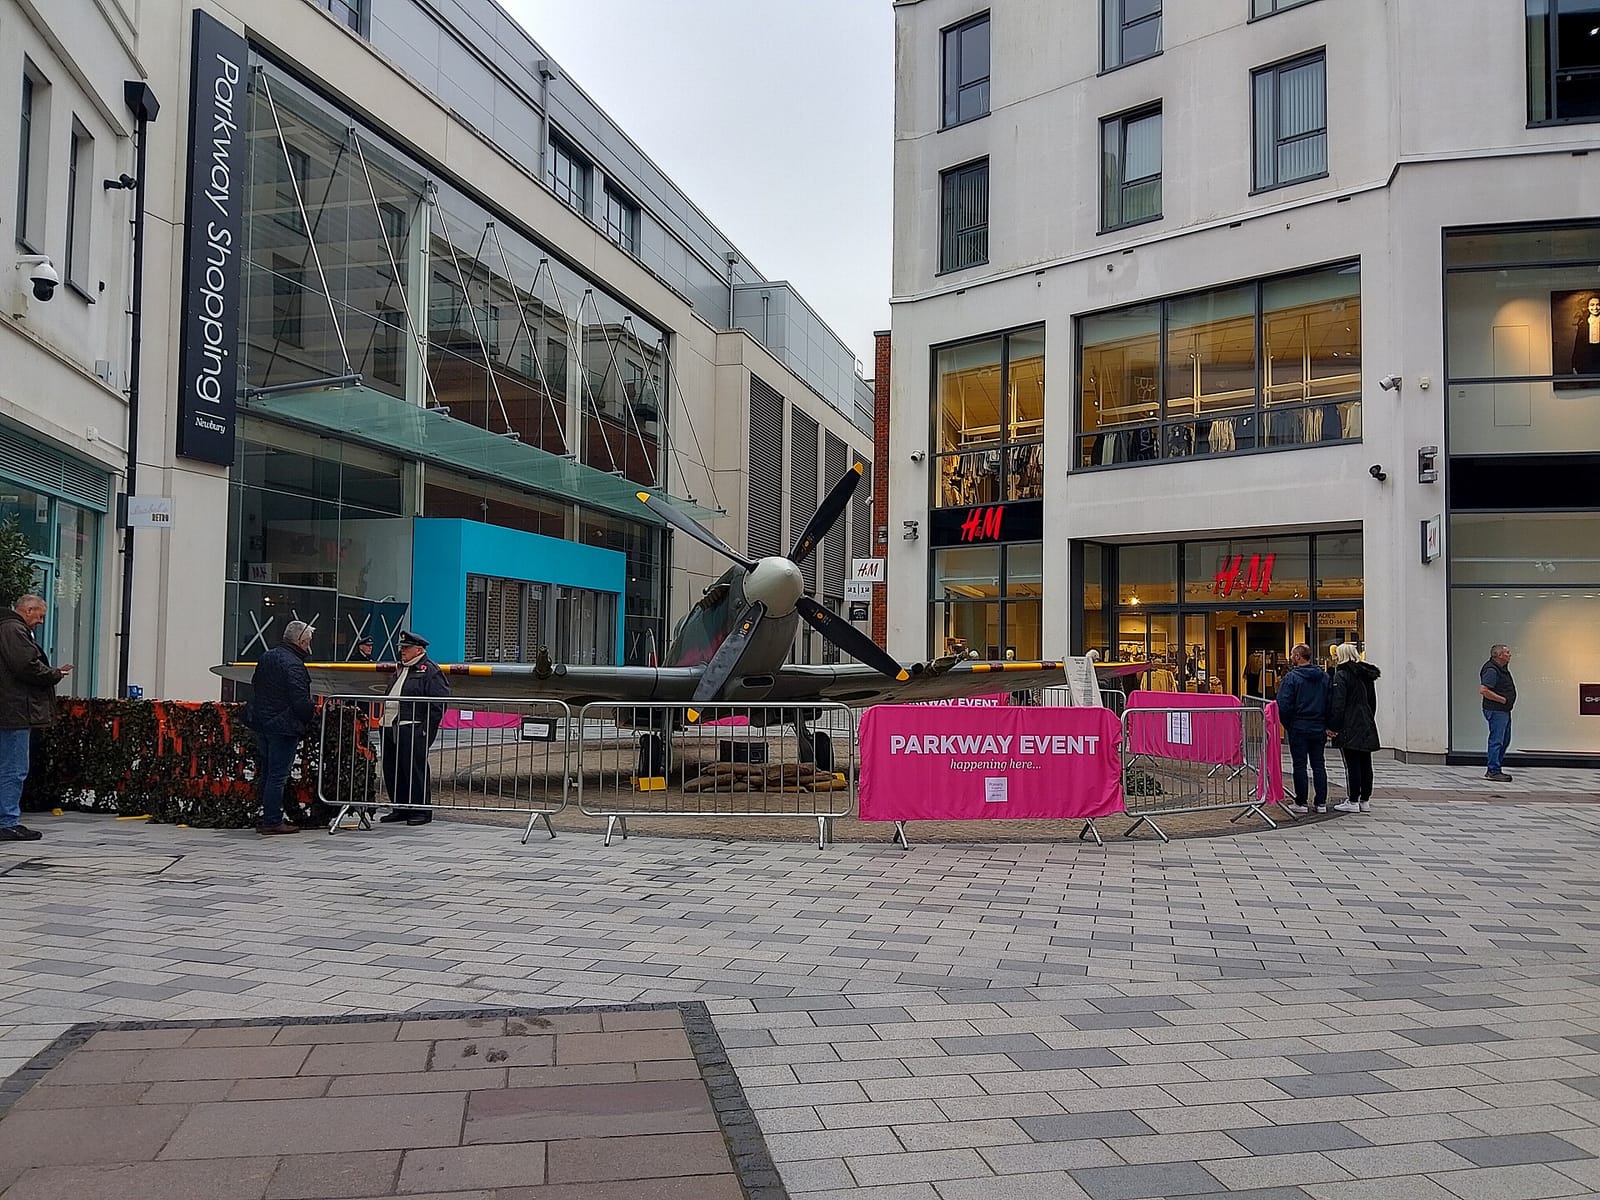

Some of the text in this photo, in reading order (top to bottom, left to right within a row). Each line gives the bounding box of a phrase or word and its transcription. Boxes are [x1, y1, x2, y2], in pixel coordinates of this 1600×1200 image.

[195, 53, 240, 404] Parkway Shopping
[195, 417, 226, 435] Newbury
[961, 505, 1005, 542] H&M
[1212, 552, 1276, 596] H&M
[890, 735, 1100, 755] PARKWAY EVENT
[950, 758, 1042, 772] happening here...
